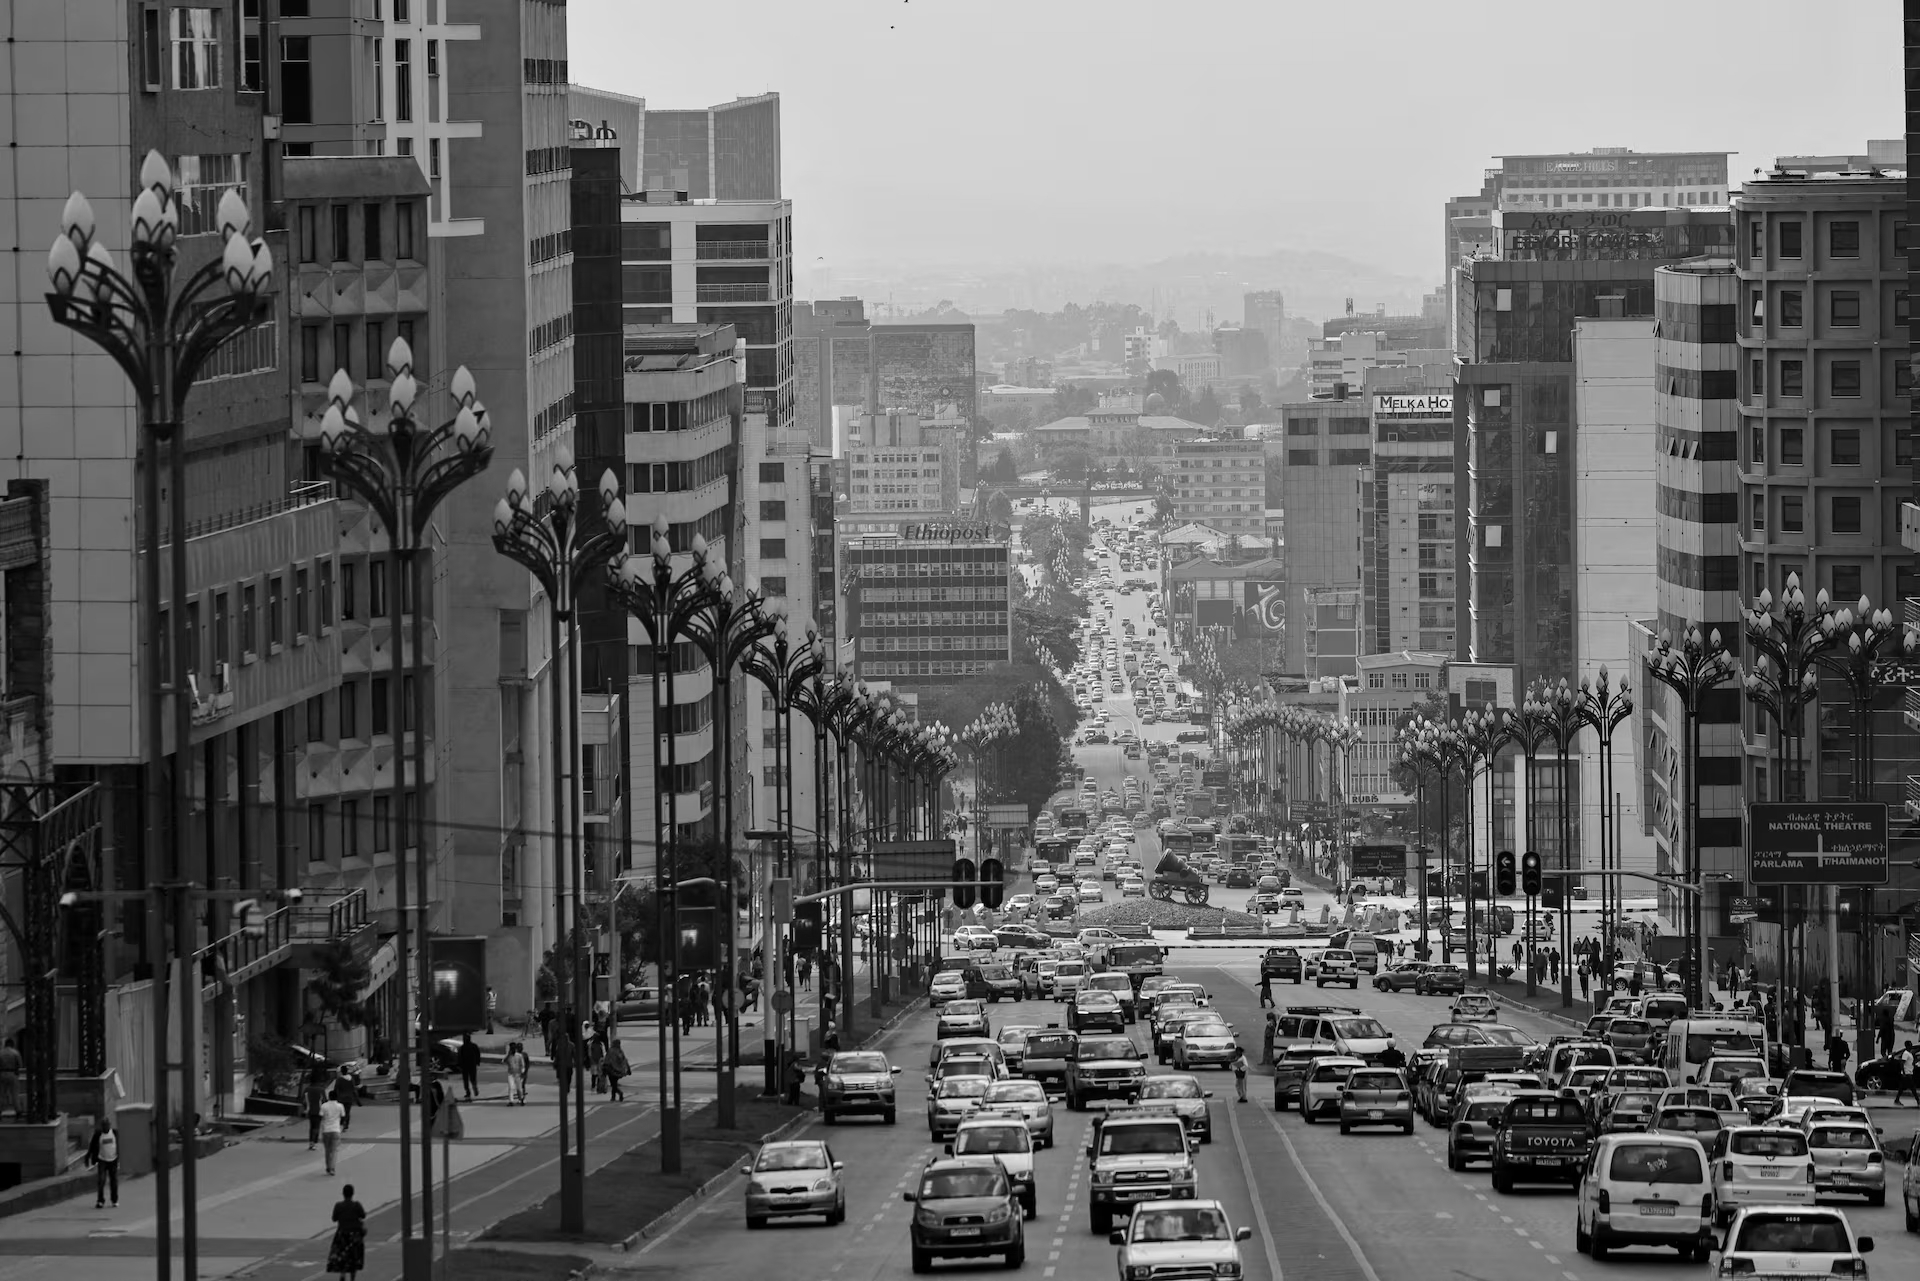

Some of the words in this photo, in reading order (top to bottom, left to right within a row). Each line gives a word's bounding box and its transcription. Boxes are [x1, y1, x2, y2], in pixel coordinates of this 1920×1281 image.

[1584, 161, 1615, 172] HILLS
[905, 524, 989, 544] Ethiopost
[1769, 822, 1821, 830] NATIONAL
[1824, 822, 1872, 830] THEATRE
[1753, 860, 1804, 868] PARLAMA
[1823, 857, 1886, 865] T/HAIMANOT
[1527, 1136, 1576, 1147] TOYOTA
